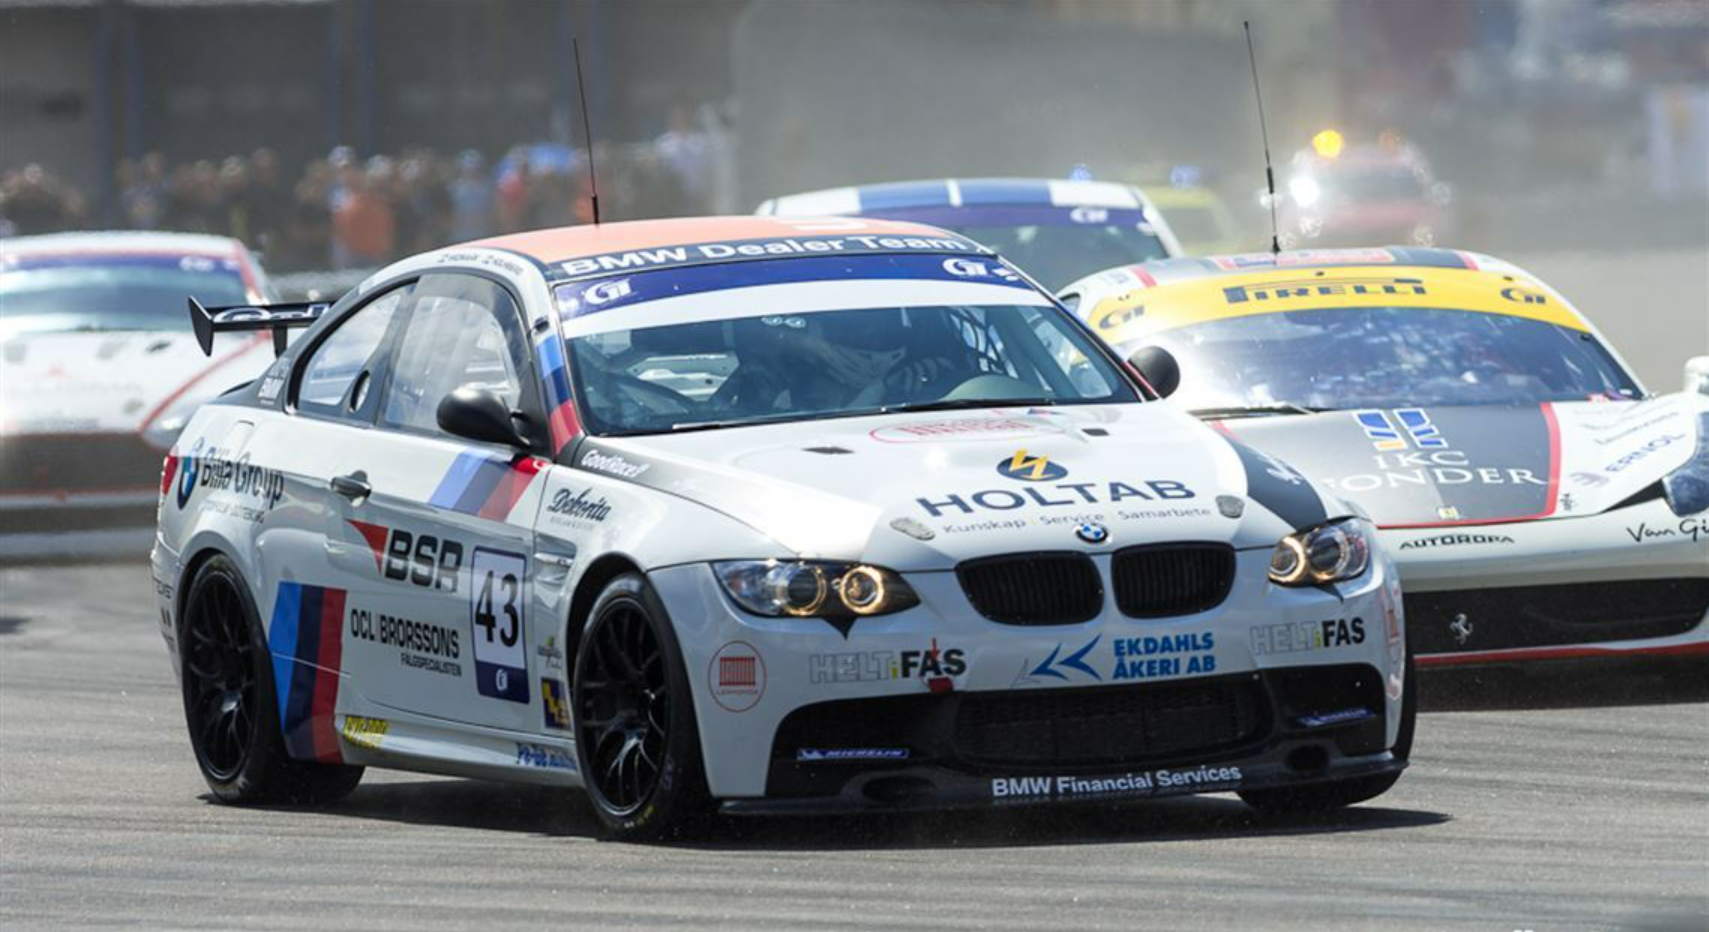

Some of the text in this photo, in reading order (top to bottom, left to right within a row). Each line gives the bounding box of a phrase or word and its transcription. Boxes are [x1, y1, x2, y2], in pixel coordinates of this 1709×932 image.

[563, 235, 967, 276] BMW Dealer Team
[1223, 277, 1427, 303] PIRELLI
[916, 480, 1196, 517] HOLTAB
[942, 507, 1211, 534] Kunskap Service Samarbete
[1626, 523, 1675, 542] Van
[384, 529, 463, 592] BSR
[475, 570, 519, 647] 43
[351, 608, 460, 659] OCL BRORSSONS
[1113, 632, 1215, 656] EKDAHLS
[1113, 654, 1216, 679] ÅKERI AB
[992, 765, 1242, 797] BMW Financial Services
